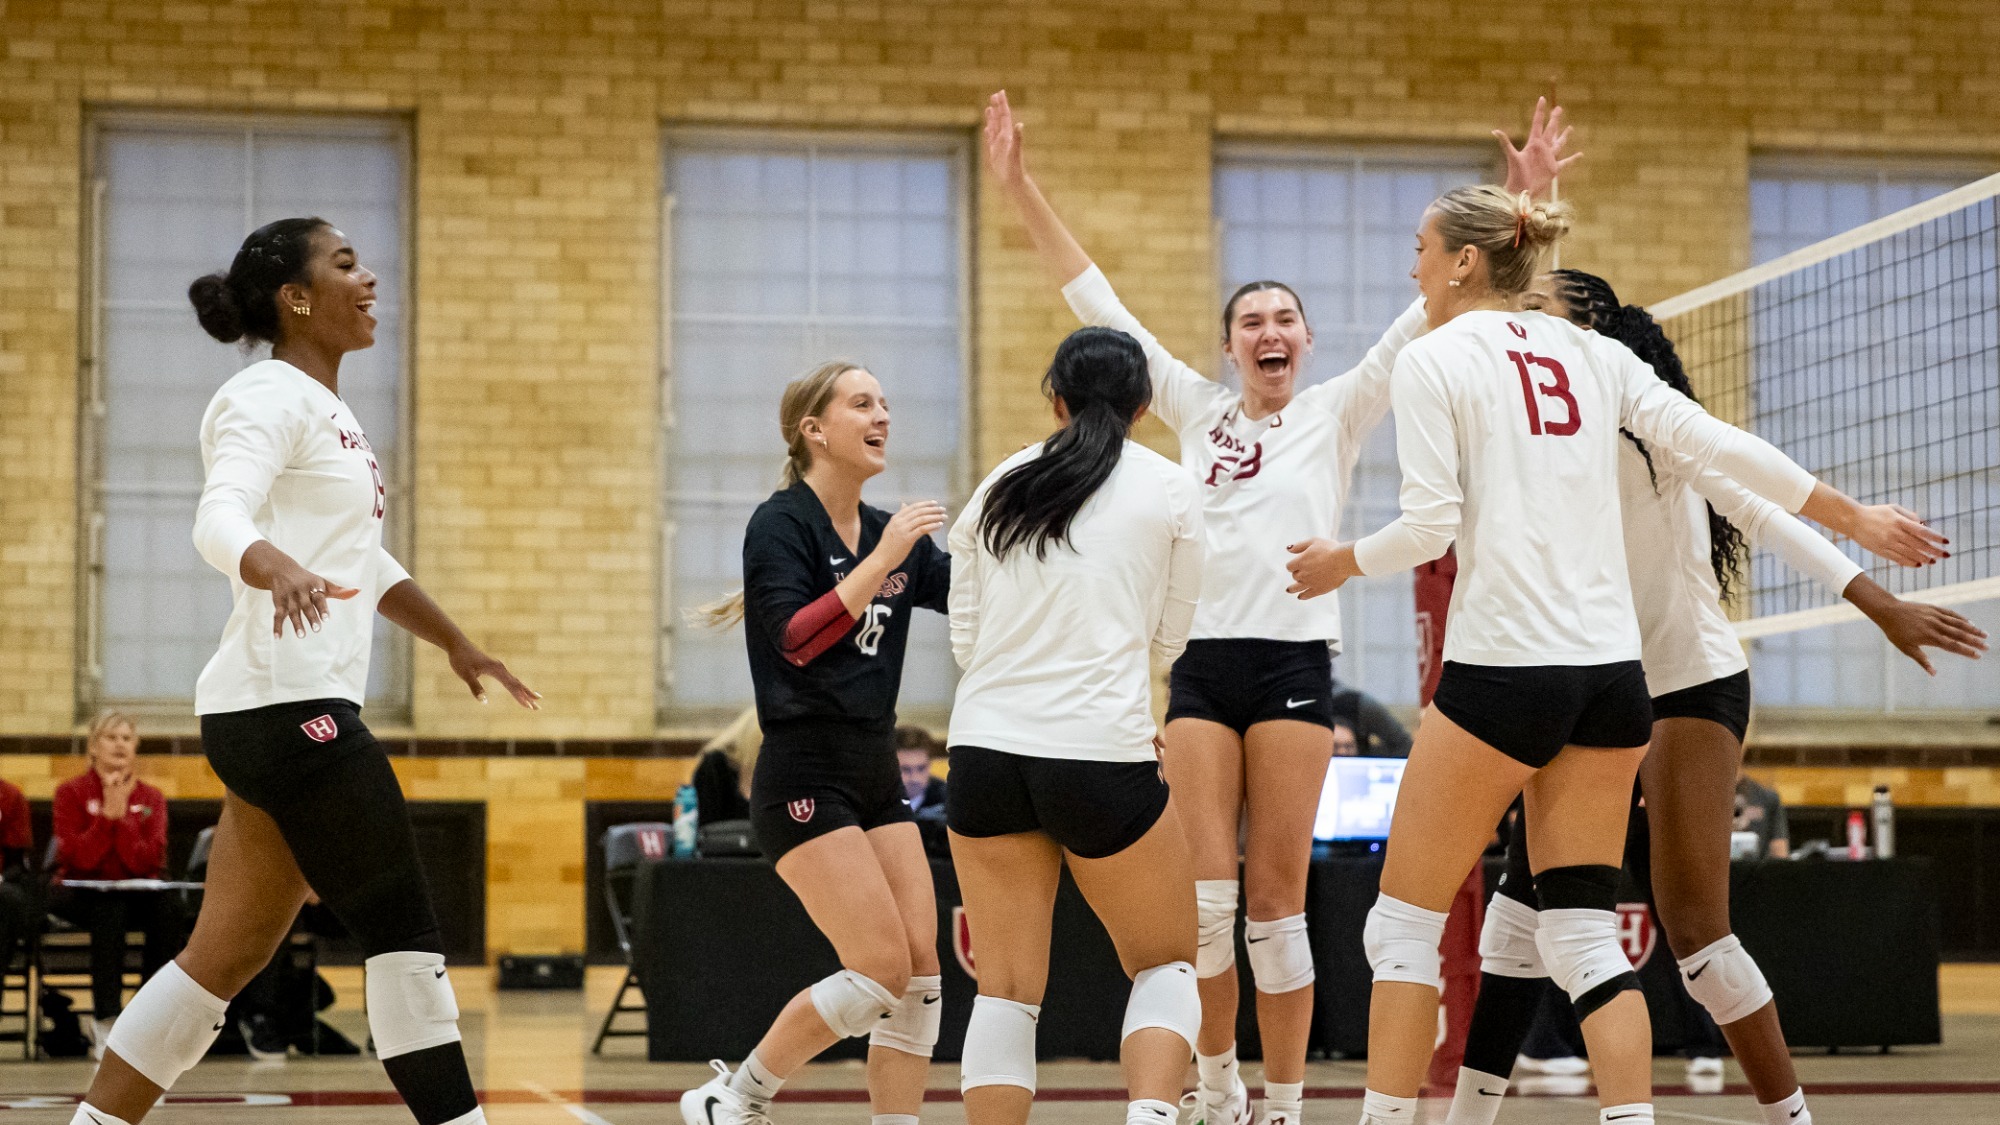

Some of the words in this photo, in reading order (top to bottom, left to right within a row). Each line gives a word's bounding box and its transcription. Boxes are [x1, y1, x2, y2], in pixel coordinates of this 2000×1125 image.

[1506, 350, 1581, 436] 13
[855, 603, 892, 656] 16
[793, 798, 810, 817] H
